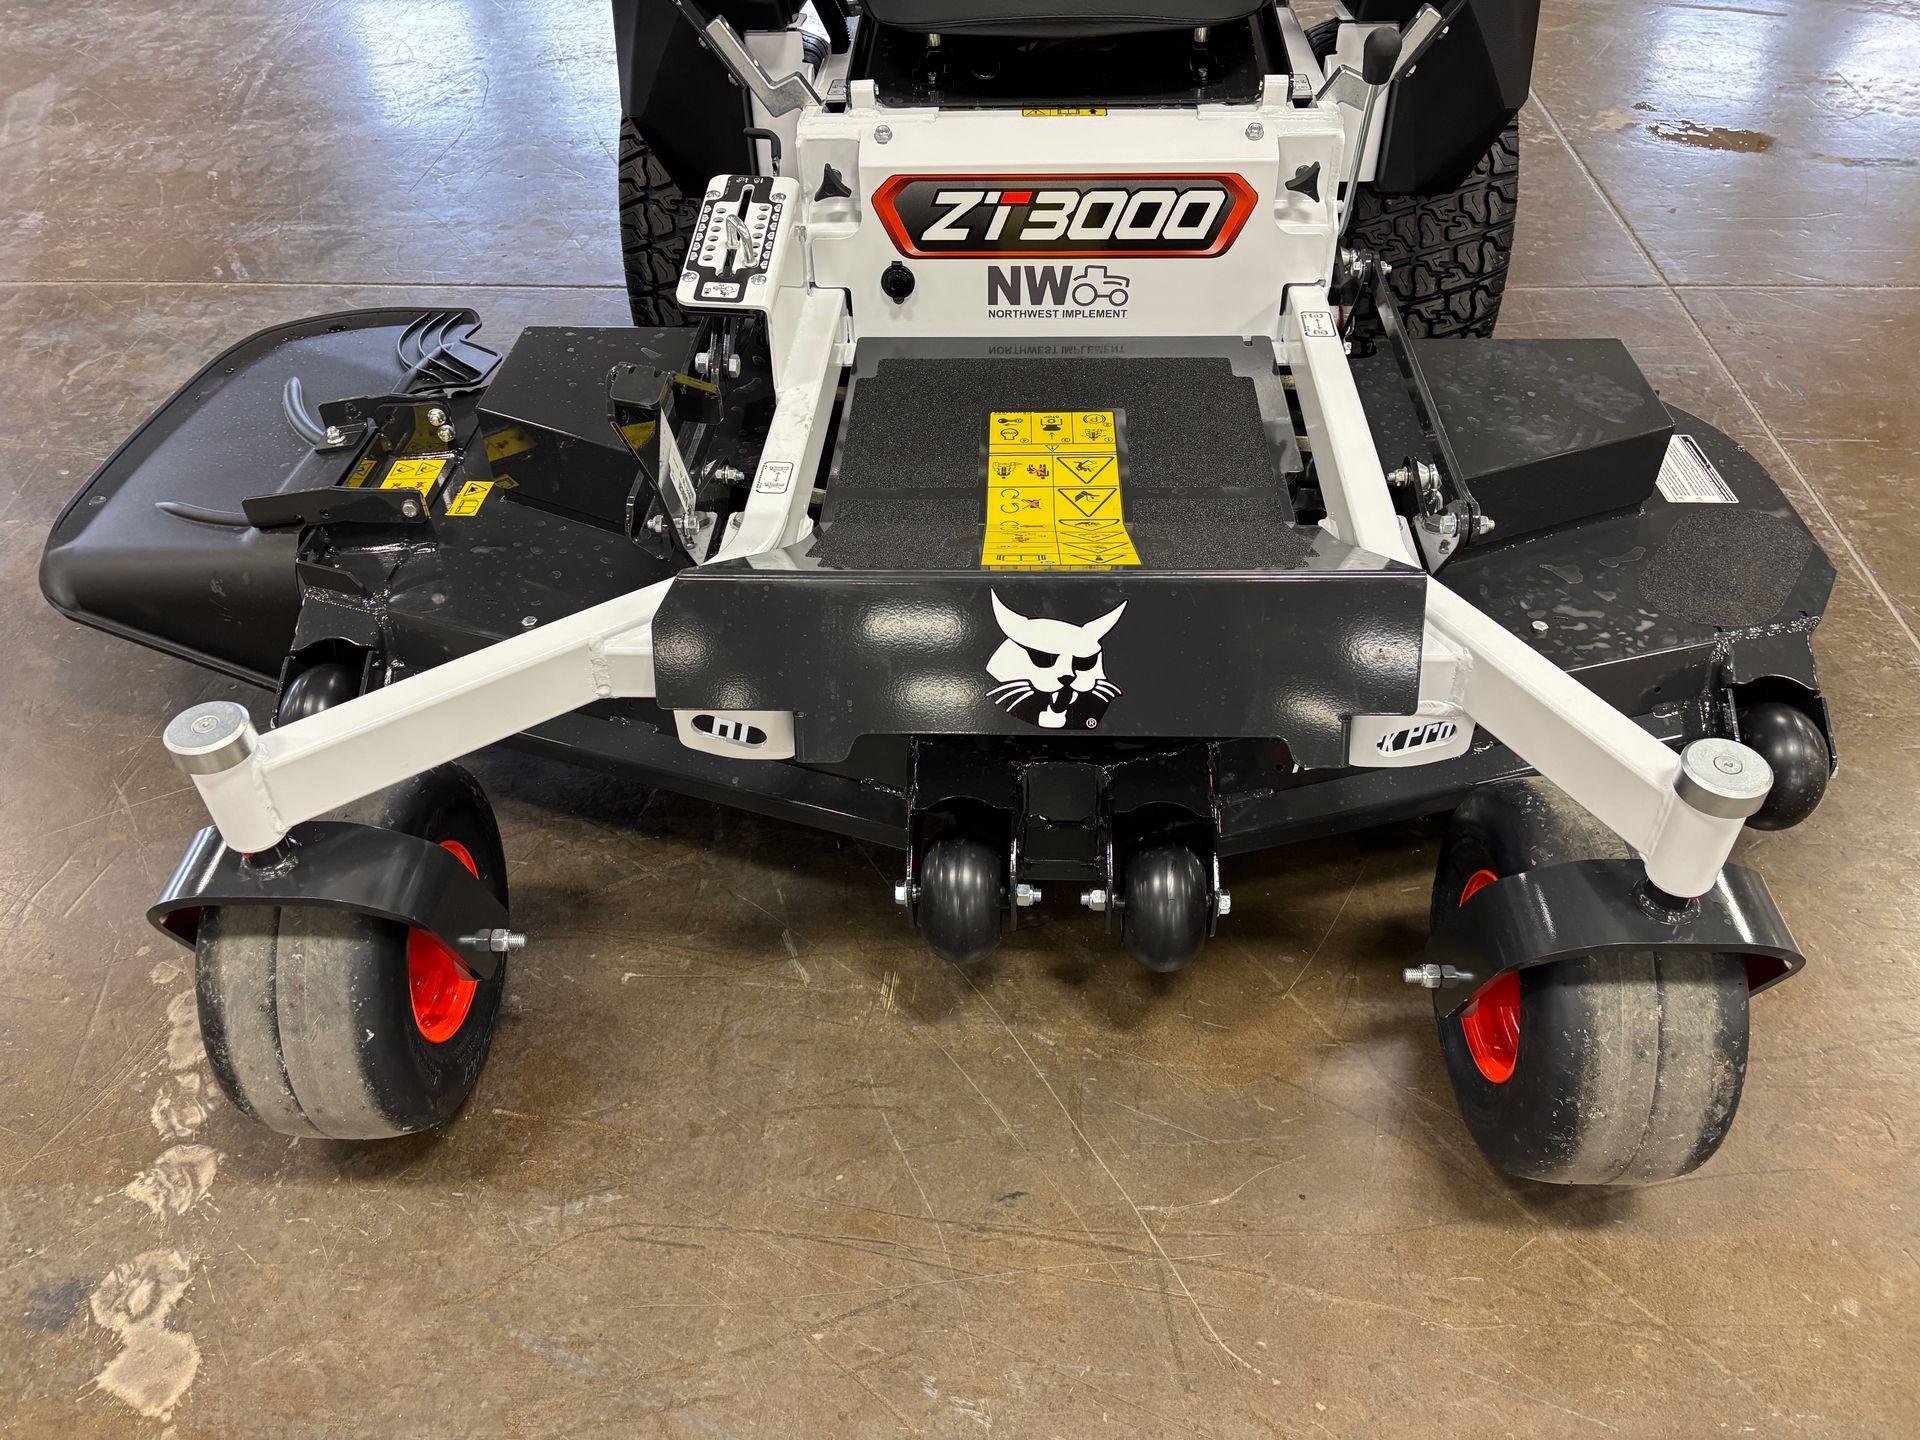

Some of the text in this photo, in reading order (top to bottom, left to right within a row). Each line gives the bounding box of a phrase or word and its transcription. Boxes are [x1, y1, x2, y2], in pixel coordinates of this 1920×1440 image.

[920, 190, 1226, 241] ZT3000
[988, 266, 1073, 305] NW
[988, 309, 1128, 318] NORTHWEST IMPLEMENT
